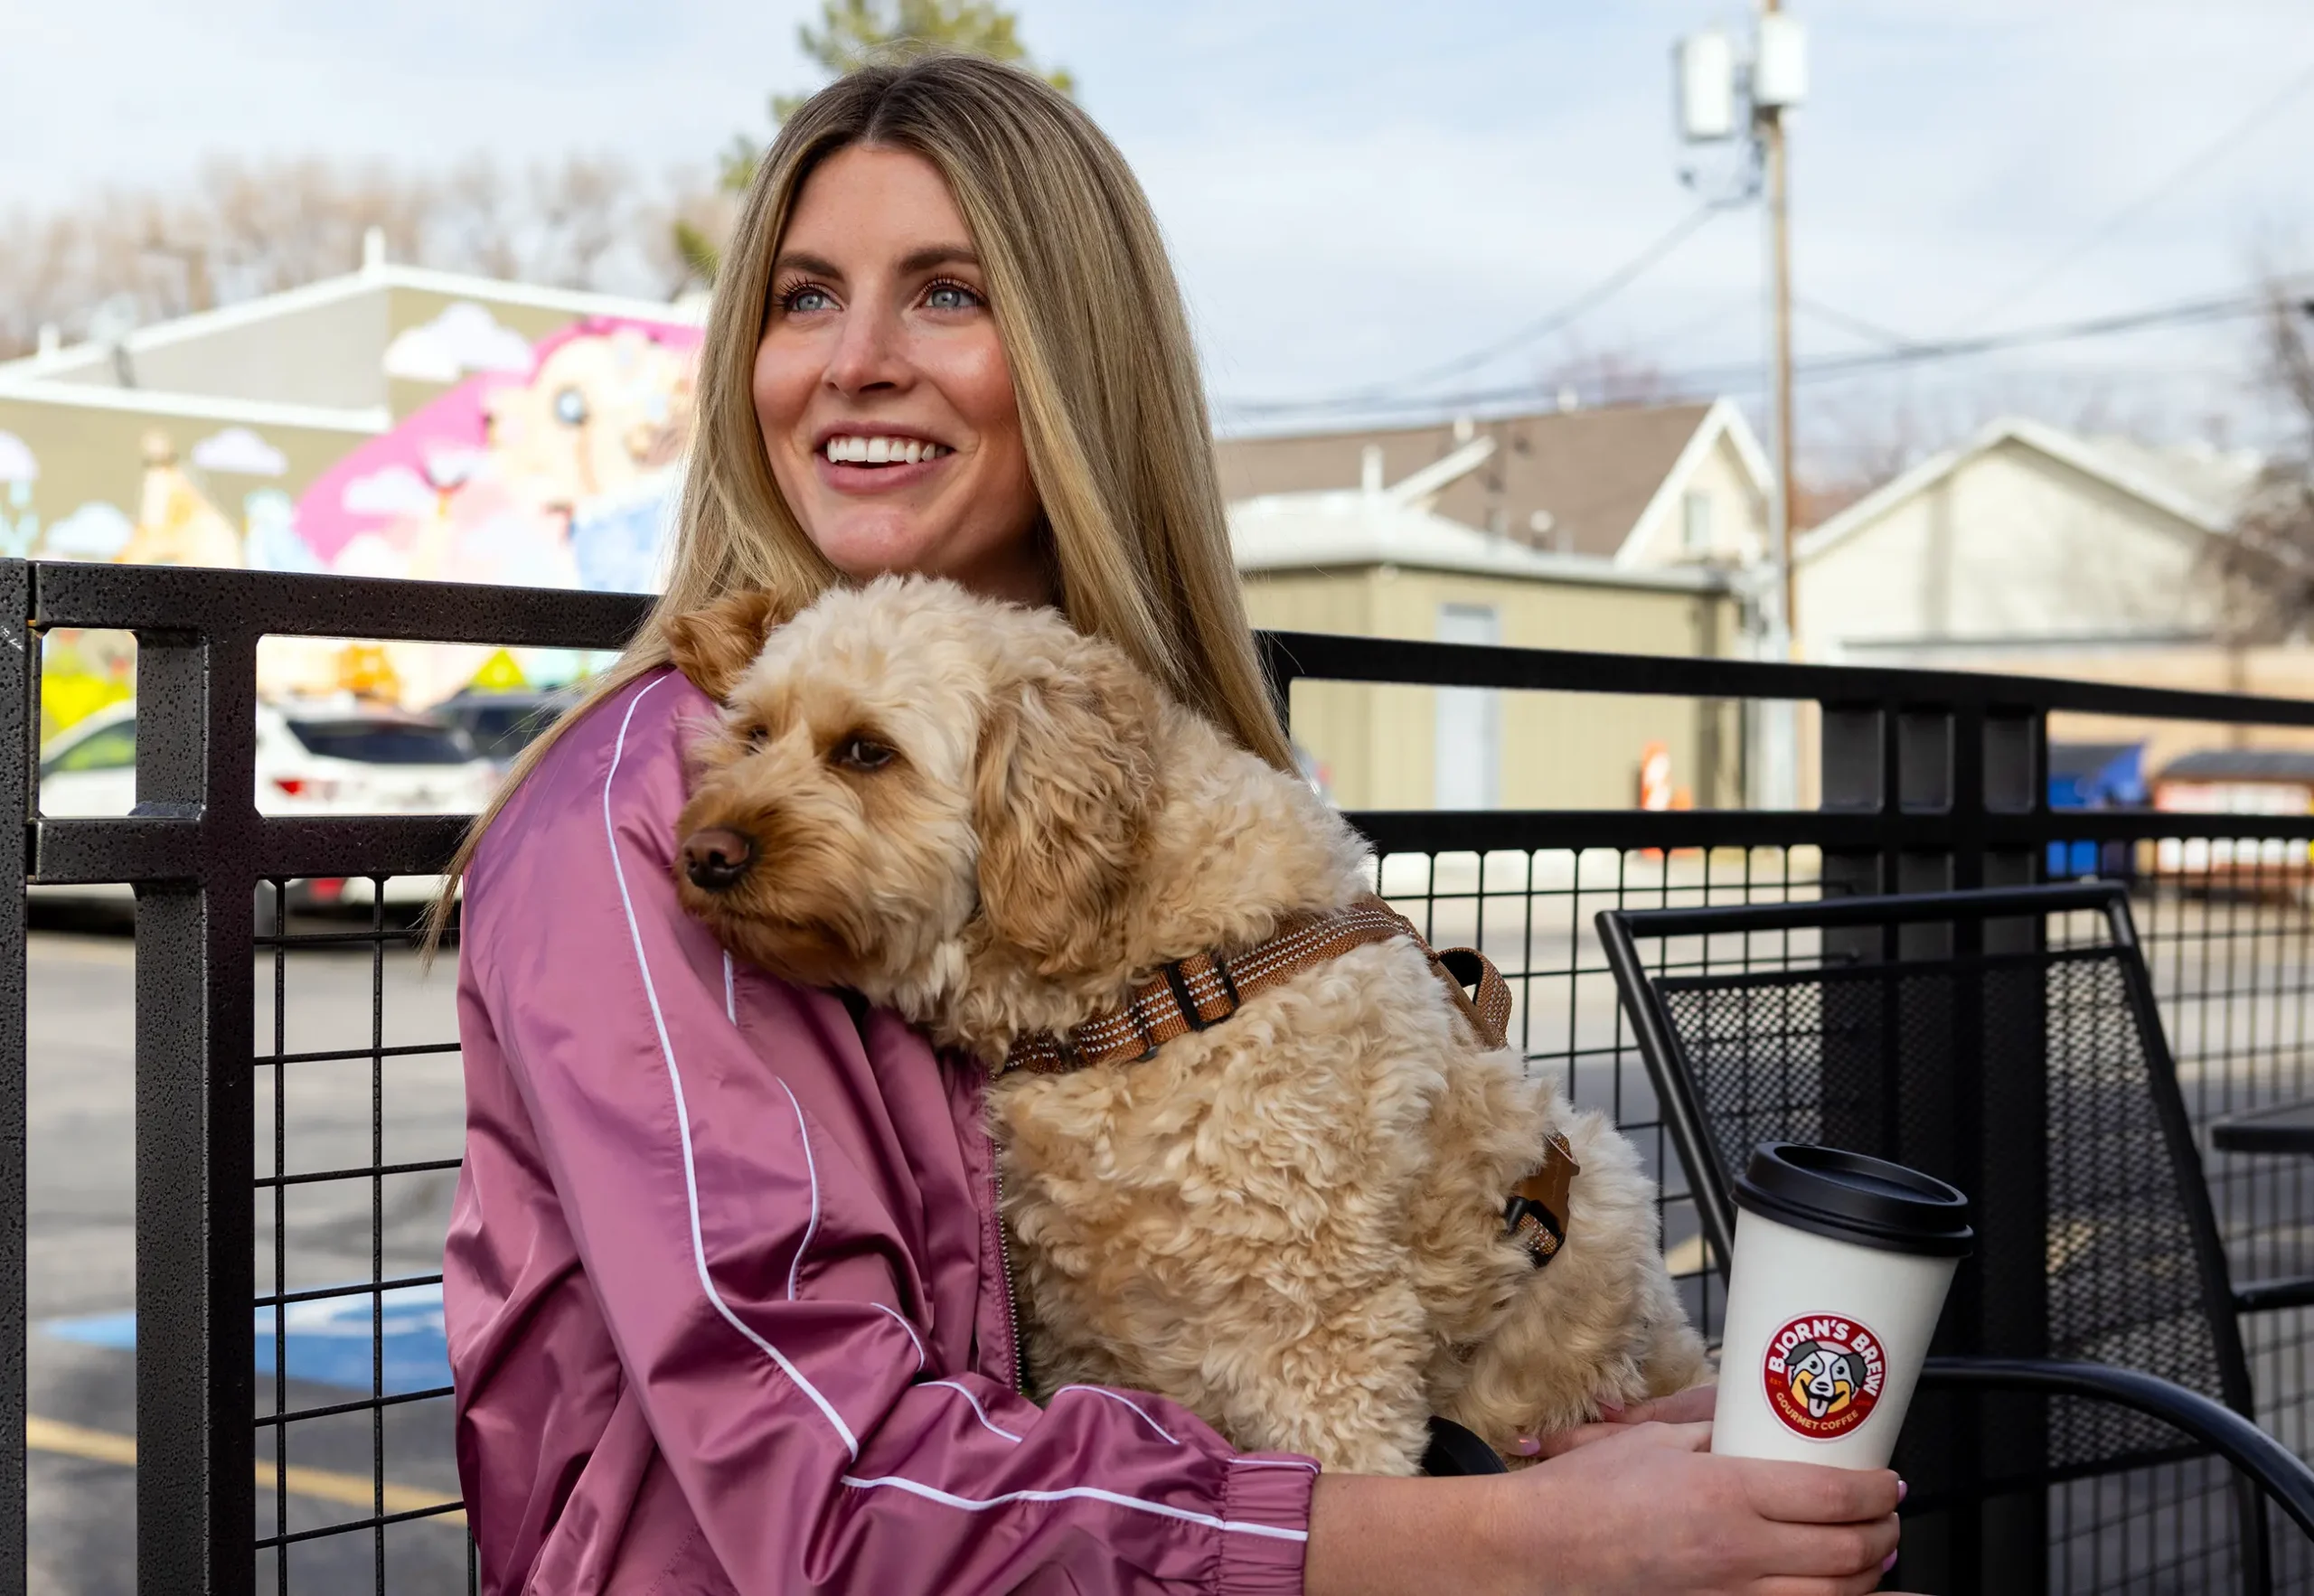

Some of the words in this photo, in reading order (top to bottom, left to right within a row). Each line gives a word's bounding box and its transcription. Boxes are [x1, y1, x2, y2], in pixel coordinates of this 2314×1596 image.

[1768, 1319, 1850, 1374] BJORN'S
[1850, 1332, 1883, 1397] BREW
[1776, 1392, 1820, 1431] GOURMET
[1820, 1409, 1859, 1431] COFFEE
